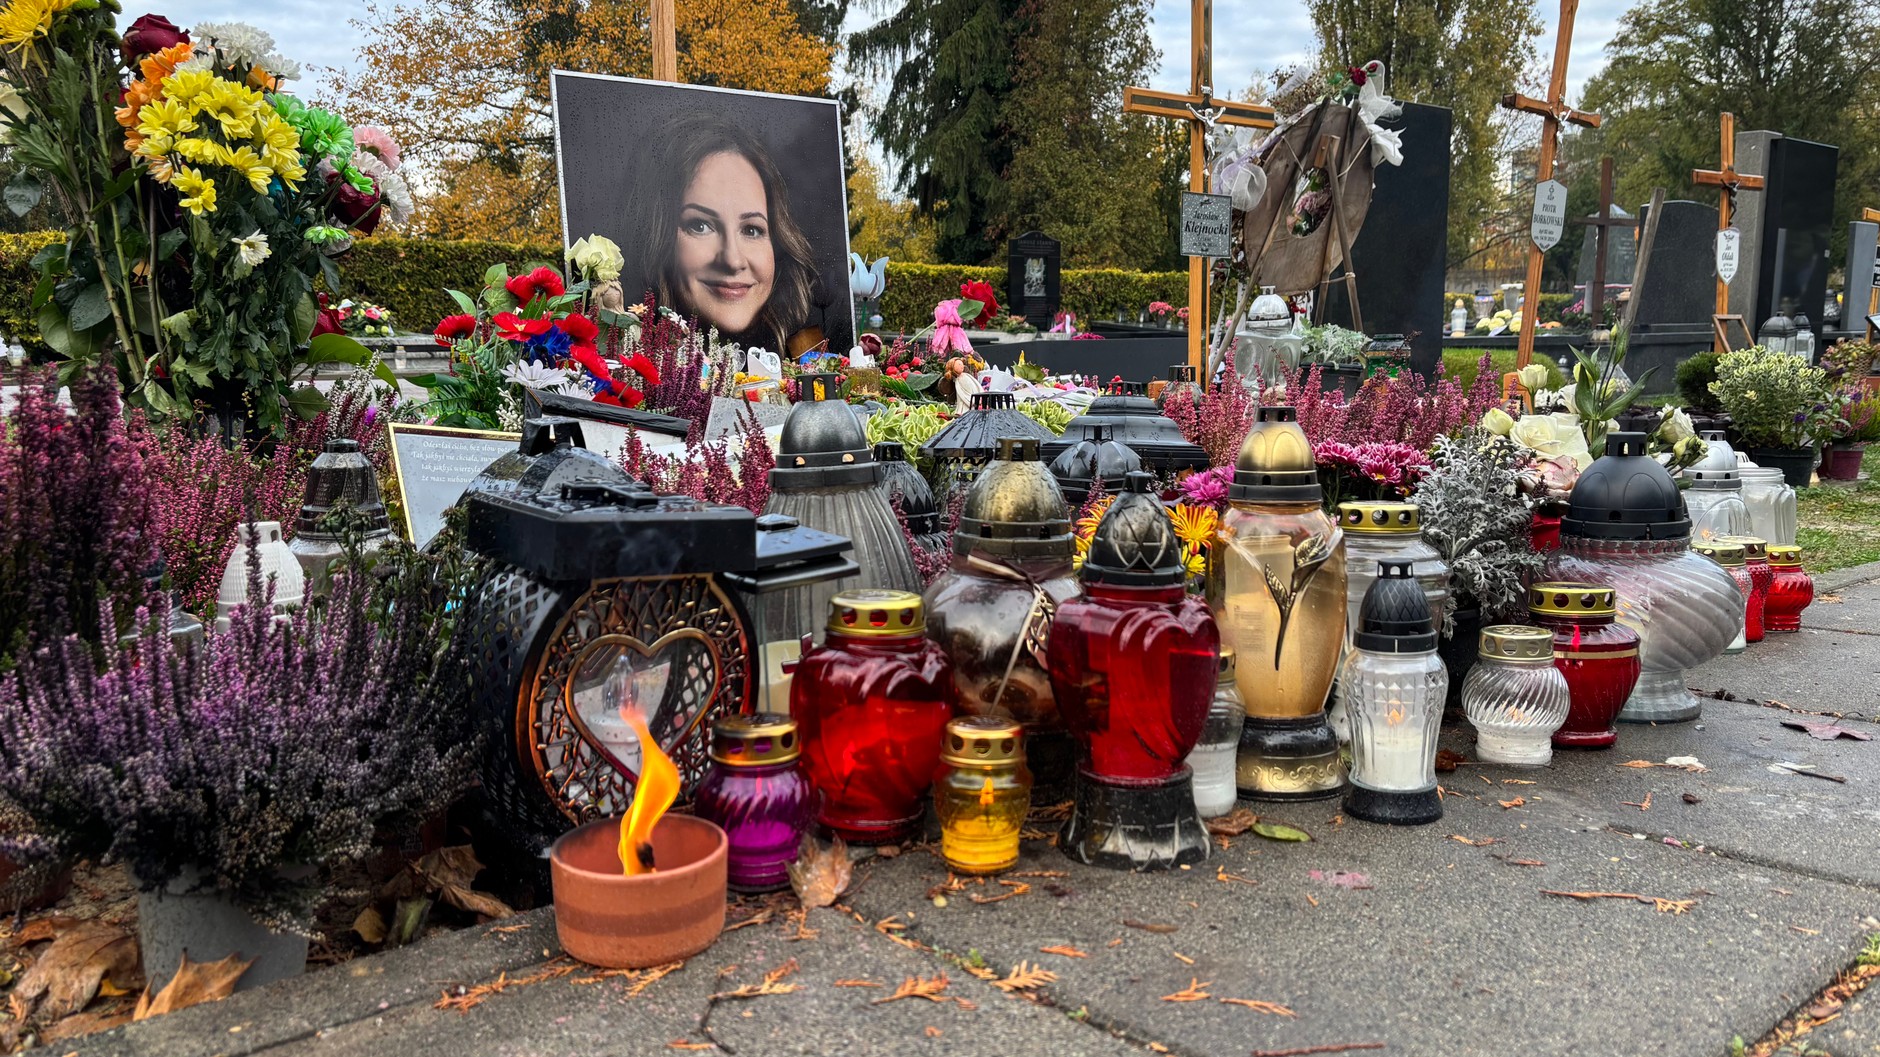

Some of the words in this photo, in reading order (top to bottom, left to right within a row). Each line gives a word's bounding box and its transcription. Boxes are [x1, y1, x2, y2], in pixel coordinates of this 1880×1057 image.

[1542, 203, 1557, 213] PIOTR
[1533, 214, 1563, 226] BORKOWSKI
[1184, 220, 1229, 236] Klejnocki
